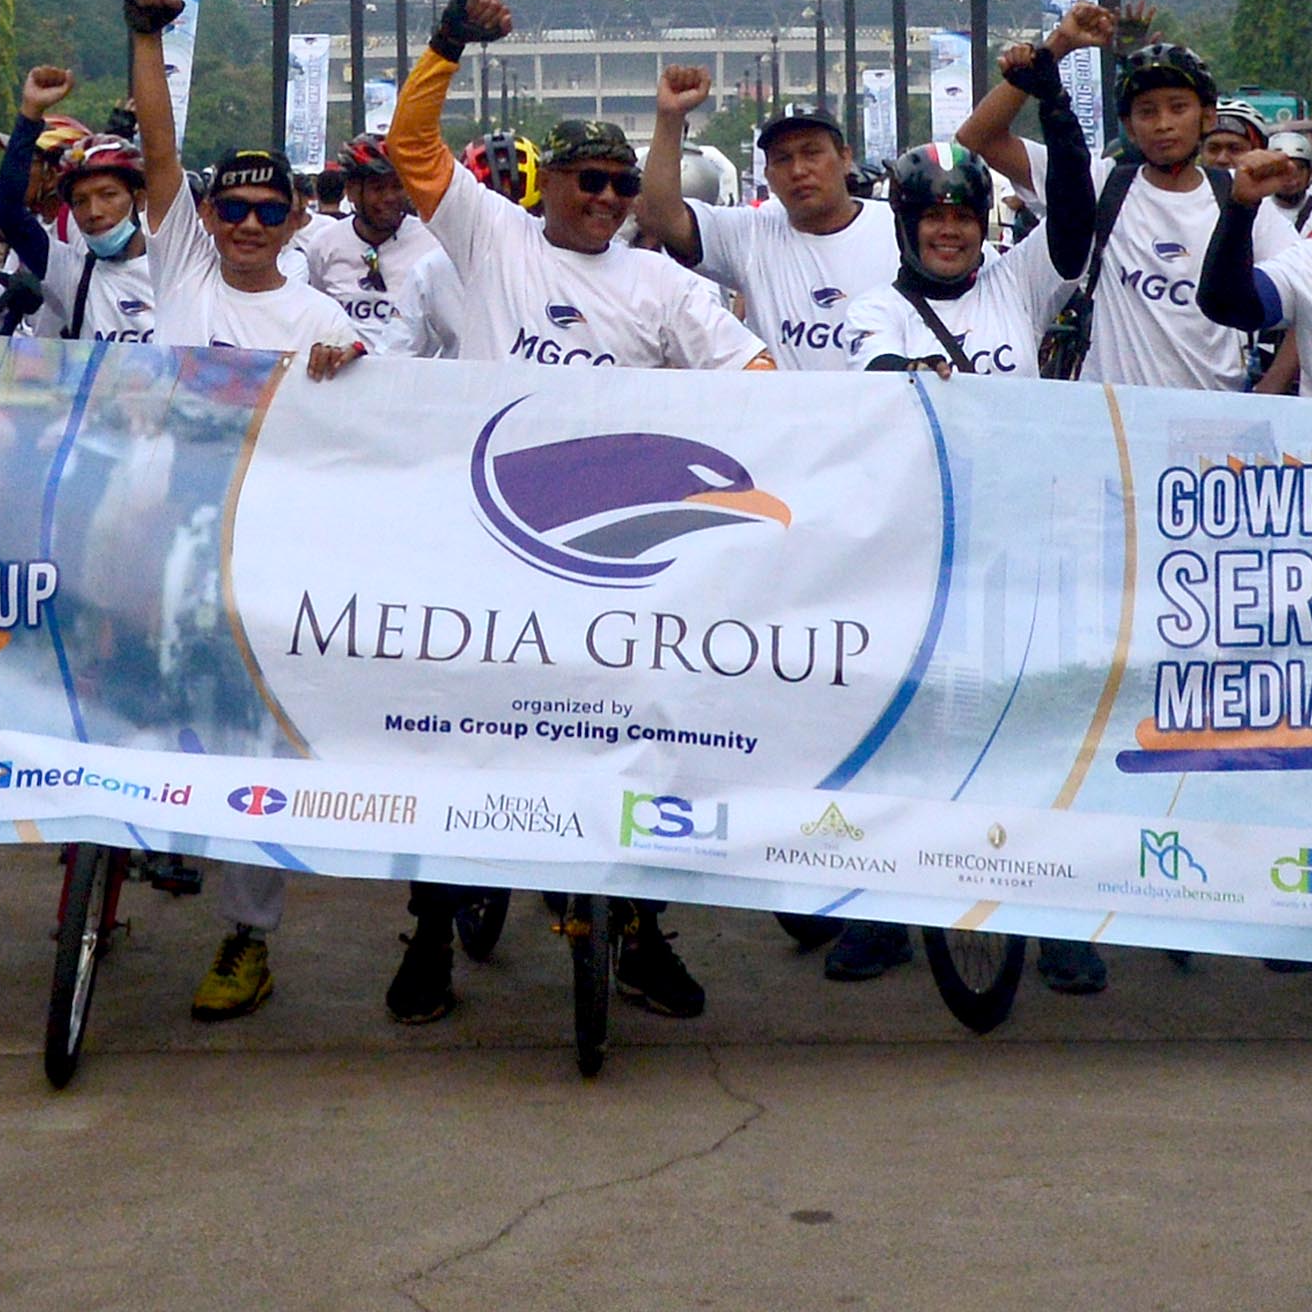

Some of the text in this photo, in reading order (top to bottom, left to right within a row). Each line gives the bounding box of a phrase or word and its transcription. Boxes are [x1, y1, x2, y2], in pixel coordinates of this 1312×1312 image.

[1120, 266, 1196, 306] MGC
[781, 320, 844, 349] MG
[971, 344, 1017, 375] CC
[286, 590, 869, 686] MEDIA GROUP
[512, 698, 633, 717] organized by
[385, 715, 759, 754] Media Group Cycling Community
[16, 766, 192, 806] medcom.id
[291, 789, 418, 825] INDOCATER
[485, 793, 550, 813] MEDIA
[445, 805, 584, 838] INDONESIA
[765, 846, 896, 874] PAPANDAYAN
[919, 850, 1077, 879] INTERCONTINENTAL
[958, 874, 1033, 888] BALI RESORT
[1097, 880, 1245, 905] mediadjayabersama
